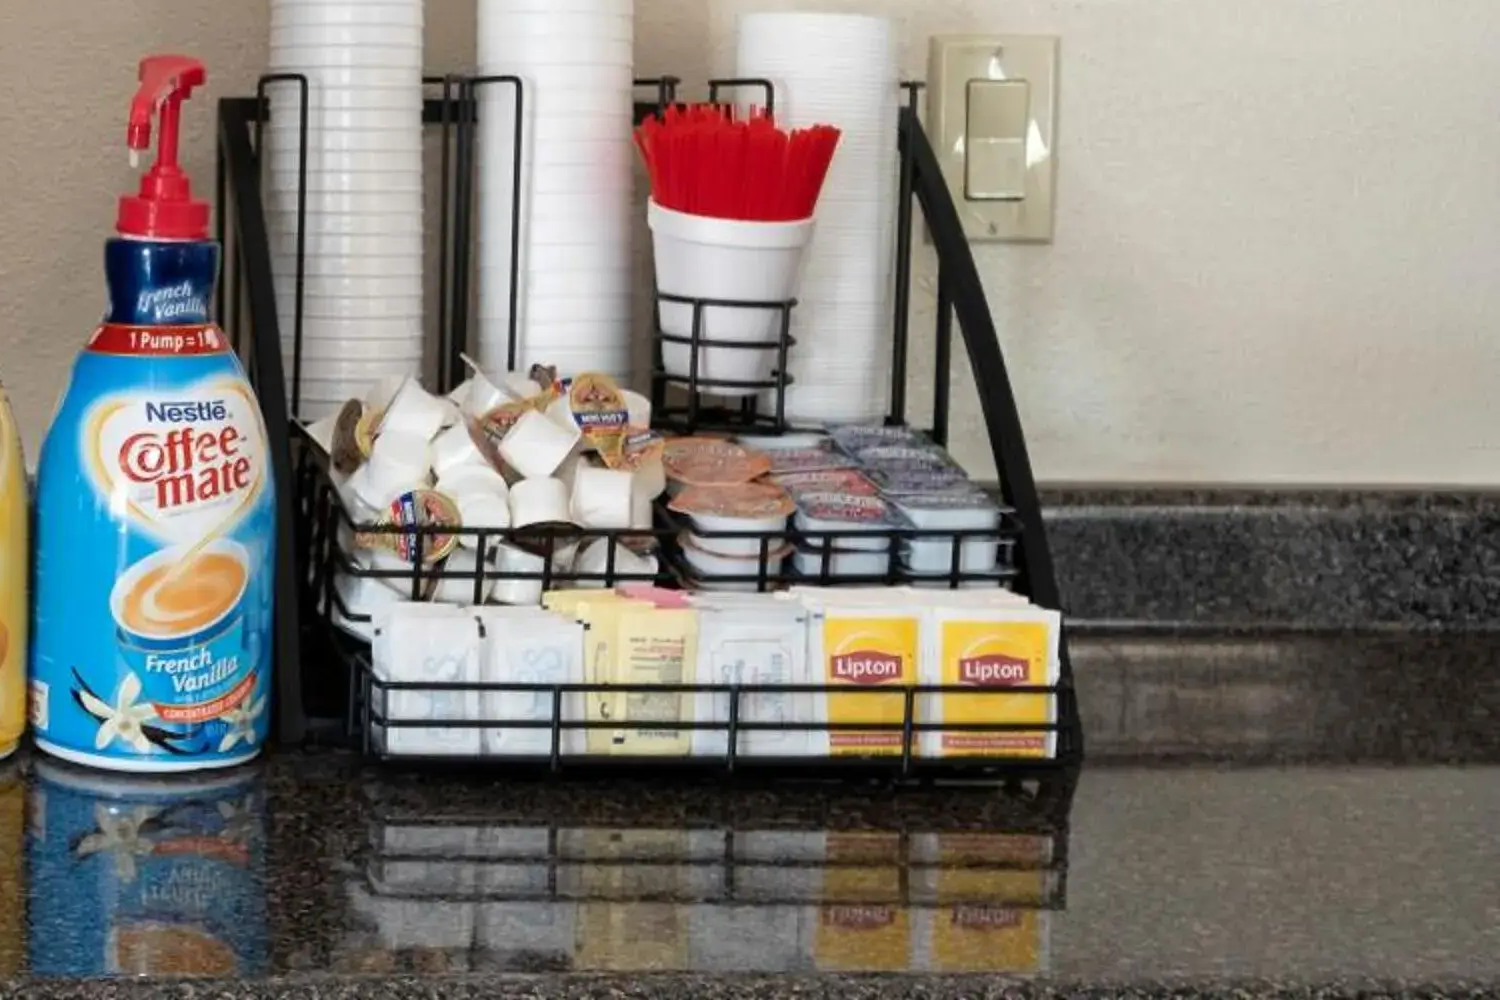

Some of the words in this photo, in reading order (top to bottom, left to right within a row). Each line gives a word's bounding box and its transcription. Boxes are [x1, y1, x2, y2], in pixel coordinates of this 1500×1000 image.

[141, 332, 184, 353] Pump
[156, 456, 250, 509] mate
[145, 647, 212, 674] French
[837, 656, 897, 678] Lipton
[964, 661, 1024, 681] Lipton
[172, 655, 238, 693] Vanilla
